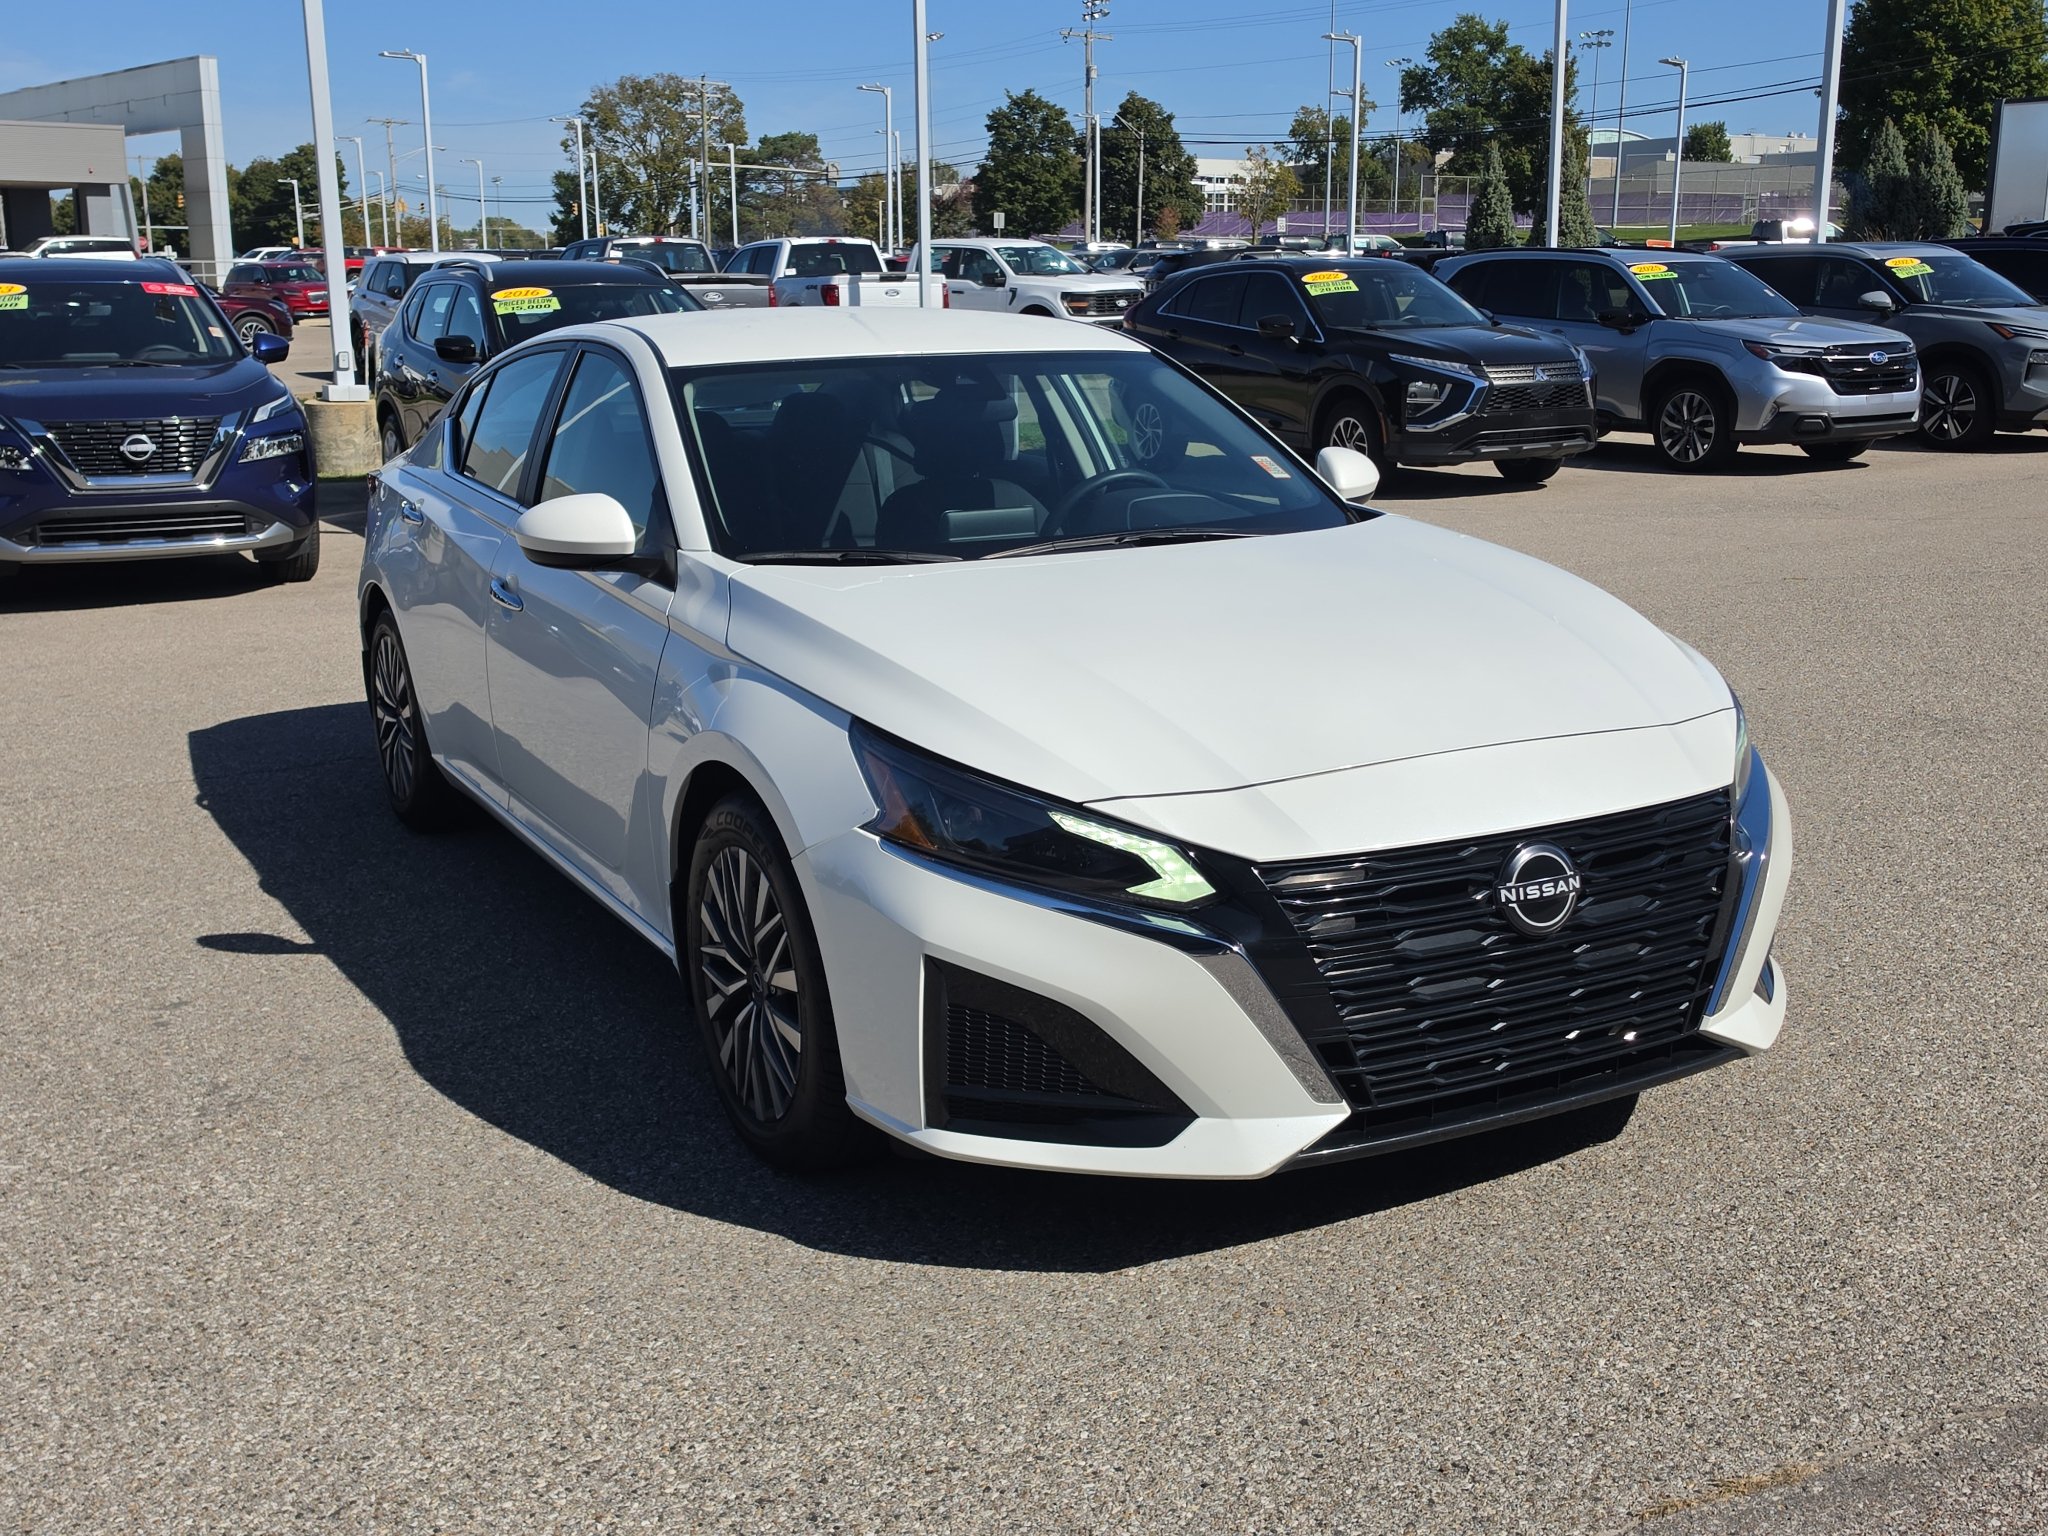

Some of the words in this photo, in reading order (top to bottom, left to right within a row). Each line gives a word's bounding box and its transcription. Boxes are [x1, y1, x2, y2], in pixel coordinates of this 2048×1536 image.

[1311, 273, 1340, 281] 2022
[502, 289, 540, 299] 2016
[498, 300, 526, 308] PRICED
[1500, 875, 1581, 903] NISSAN
